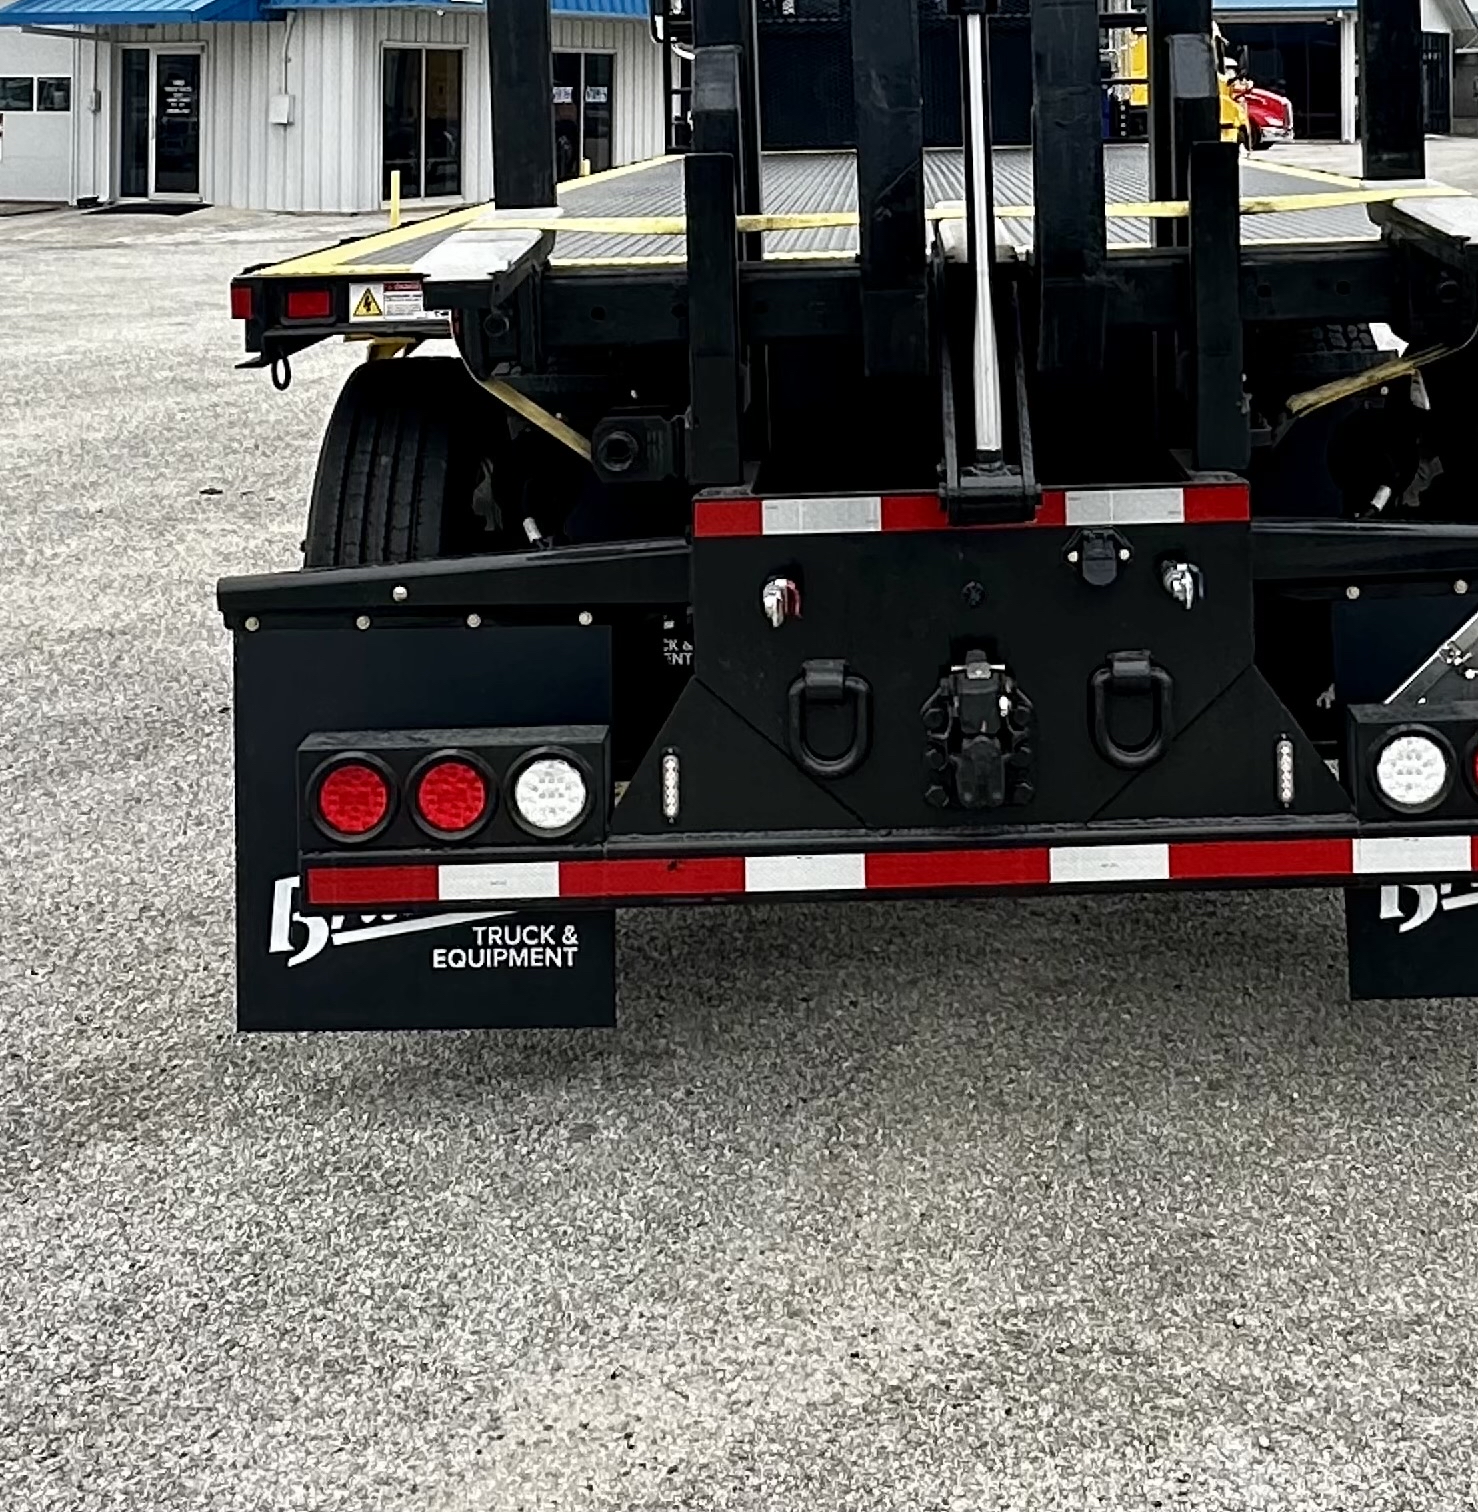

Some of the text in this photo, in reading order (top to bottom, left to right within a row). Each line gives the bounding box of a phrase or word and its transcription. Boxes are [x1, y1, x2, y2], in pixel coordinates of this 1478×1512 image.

[472, 925, 579, 946] TRUCK &
[432, 947, 579, 968] EQUIPMENT
